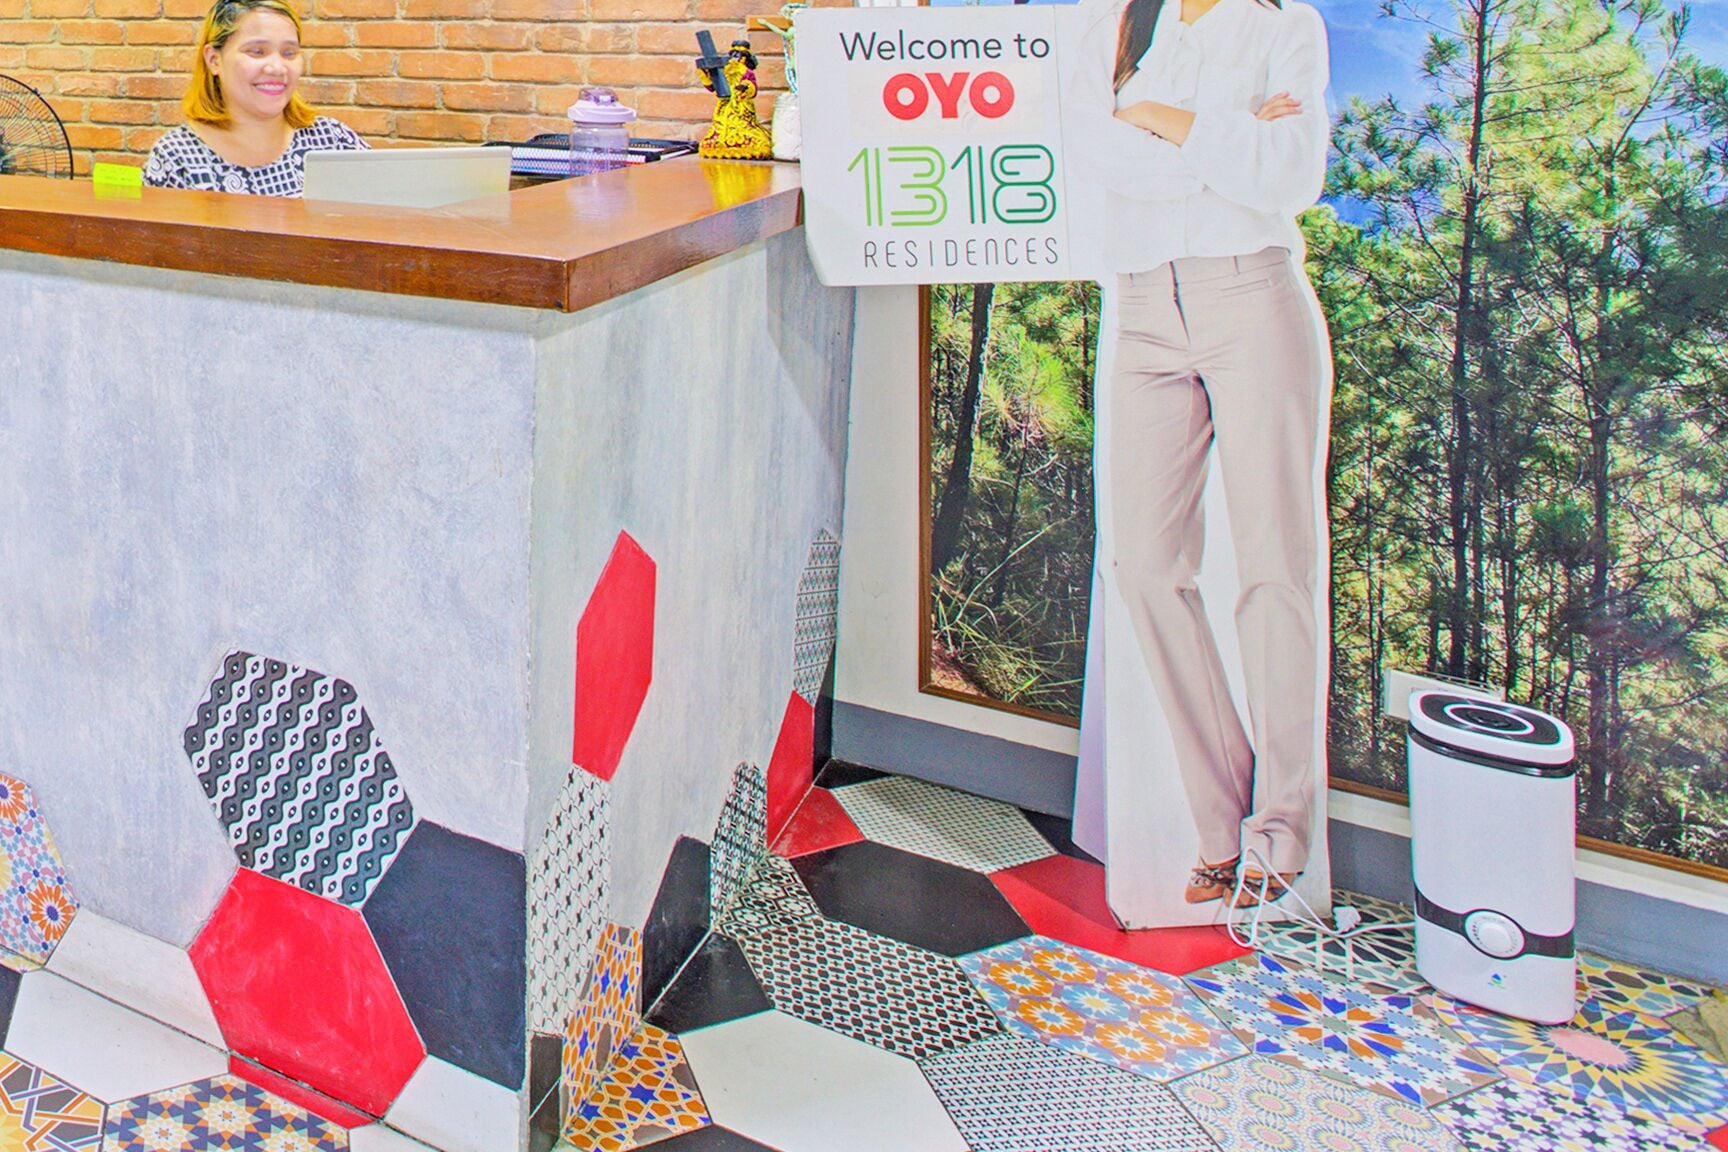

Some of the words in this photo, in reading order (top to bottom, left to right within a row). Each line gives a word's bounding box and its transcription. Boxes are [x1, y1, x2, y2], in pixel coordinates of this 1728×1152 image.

[839, 29, 1002, 61] Welcome
[1014, 33, 1051, 59] to
[883, 71, 1016, 121] OYO
[847, 144, 1057, 227] 1318
[864, 237, 1059, 268] RESIDENCES
